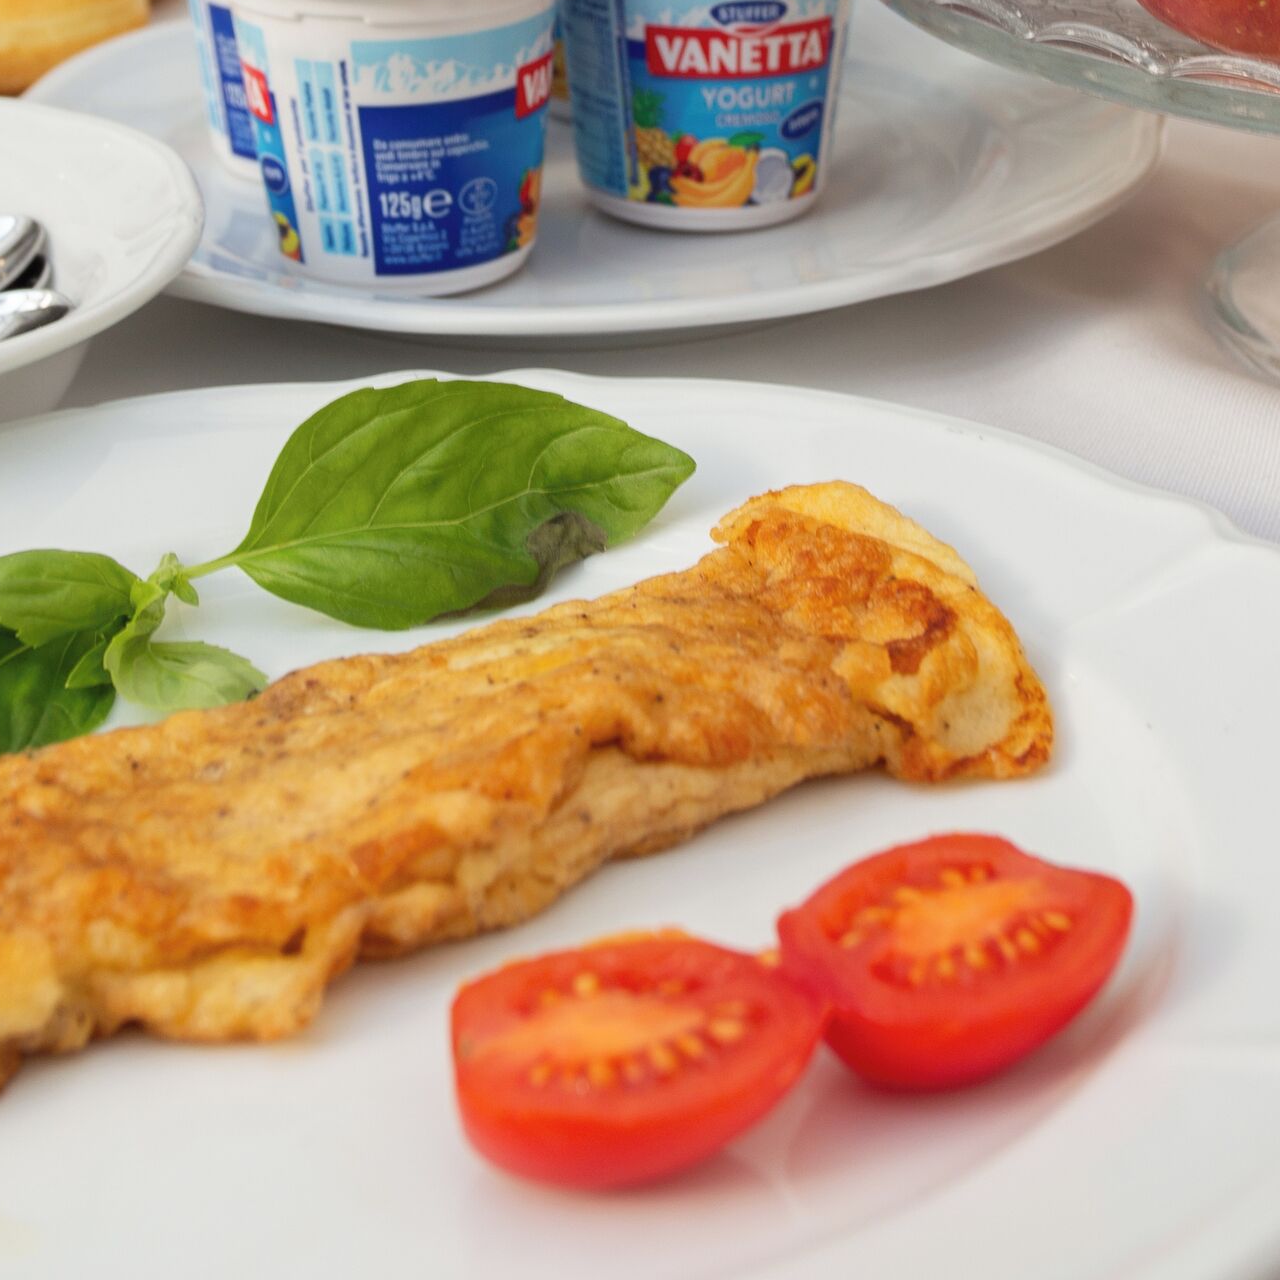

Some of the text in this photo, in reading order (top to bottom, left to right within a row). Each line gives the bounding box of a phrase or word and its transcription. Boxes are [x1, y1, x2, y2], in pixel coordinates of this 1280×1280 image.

[719, 3, 781, 20] STUFFER
[653, 28, 824, 75] VANETTA
[701, 82, 797, 110] YOGURT
[380, 191, 422, 221] 125g
